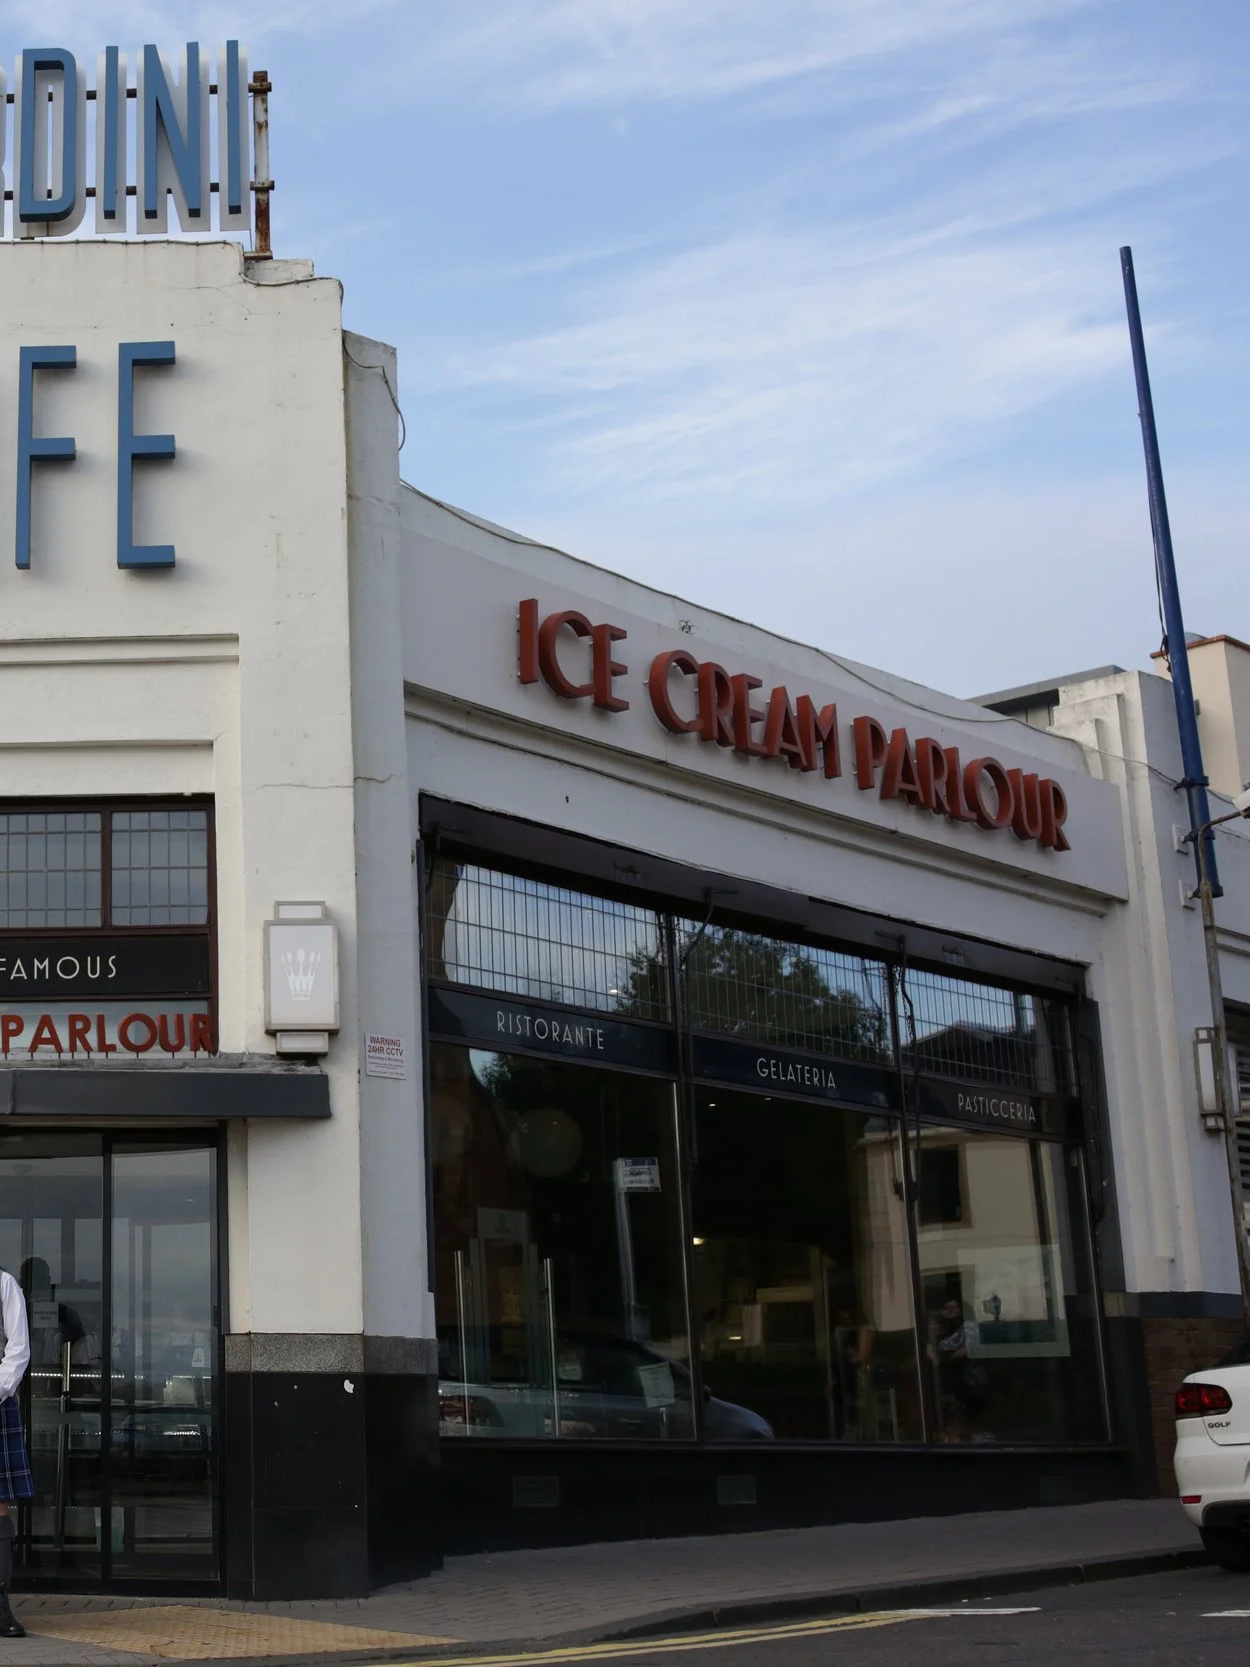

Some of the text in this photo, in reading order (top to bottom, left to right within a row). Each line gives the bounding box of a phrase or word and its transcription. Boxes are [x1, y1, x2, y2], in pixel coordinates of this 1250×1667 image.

[518, 598, 1072, 852] ICE CREAM PARLOUR
[1, 1012, 219, 1054] PARLOUR
[369, 1035, 401, 1048] WARNING
[497, 1010, 604, 1050] RISTORANTE
[367, 1044, 404, 1057] 24HR CCTV
[756, 1057, 836, 1089] GELATERIA
[957, 1092, 1037, 1122] PASTICCERIA
[1207, 1421, 1231, 1429] GOLF
